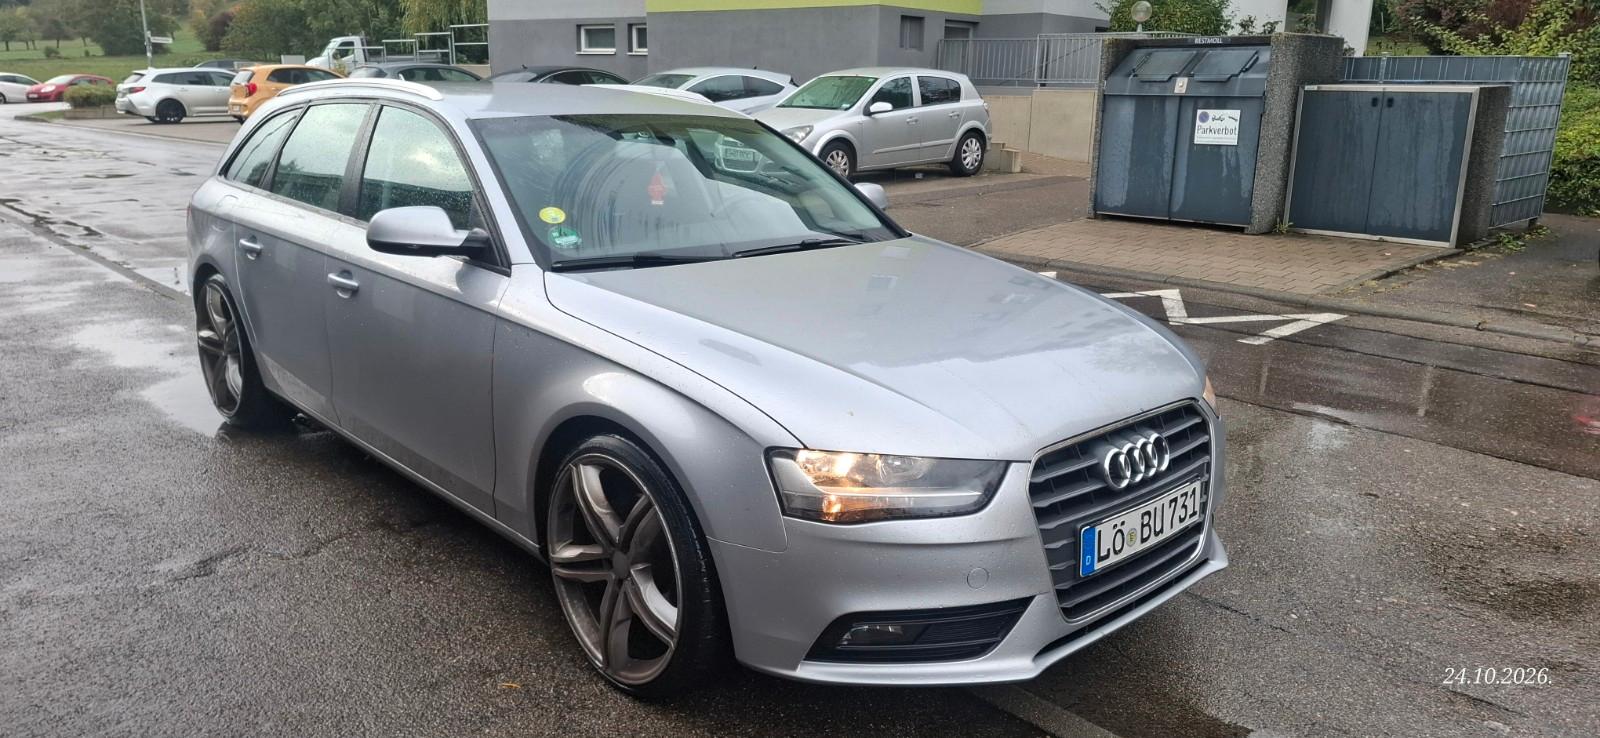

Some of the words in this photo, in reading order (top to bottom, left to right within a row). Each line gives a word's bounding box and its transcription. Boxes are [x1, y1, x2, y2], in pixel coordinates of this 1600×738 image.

[1197, 125, 1237, 136] Parkverbot
[1097, 520, 1126, 563] LÖ
[1140, 503, 1165, 544] BU
[1168, 487, 1198, 530] 731
[1085, 555, 1092, 566] D
